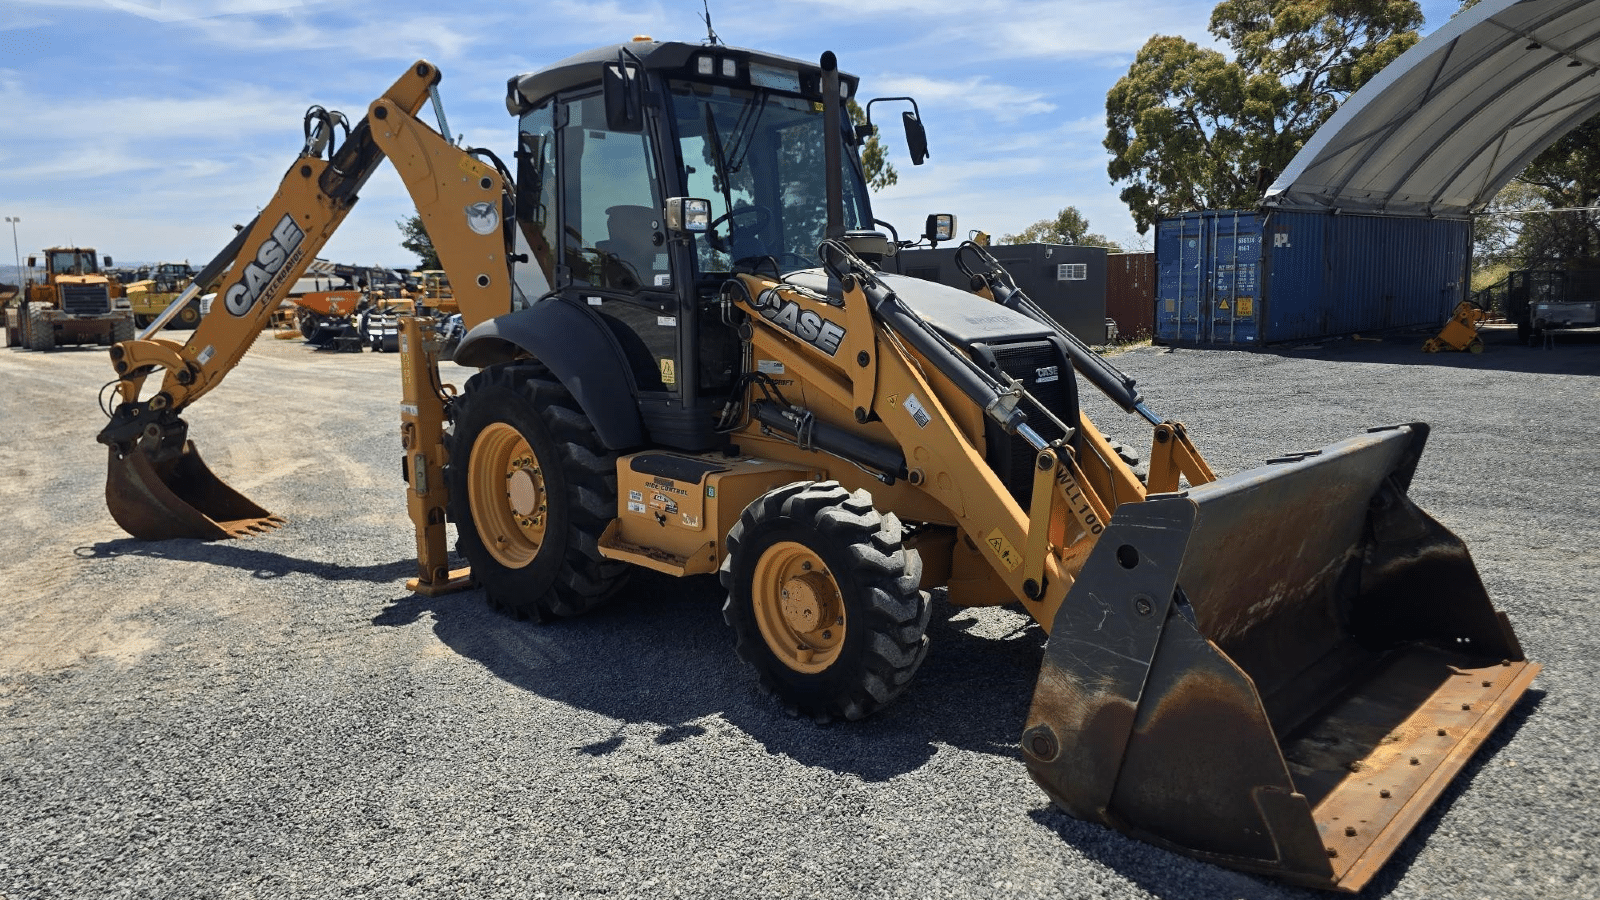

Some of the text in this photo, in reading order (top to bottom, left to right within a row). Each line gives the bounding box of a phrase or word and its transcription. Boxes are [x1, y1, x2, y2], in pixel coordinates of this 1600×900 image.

[224, 213, 305, 317] CASE
[260, 248, 304, 307] EXTENDAHOE
[757, 288, 847, 357] CASE
[1036, 366, 1058, 378] CASE
[644, 481, 659, 490] RIDE
[660, 486, 689, 496] CONTROL
[1056, 468, 1103, 535] WLL 100
